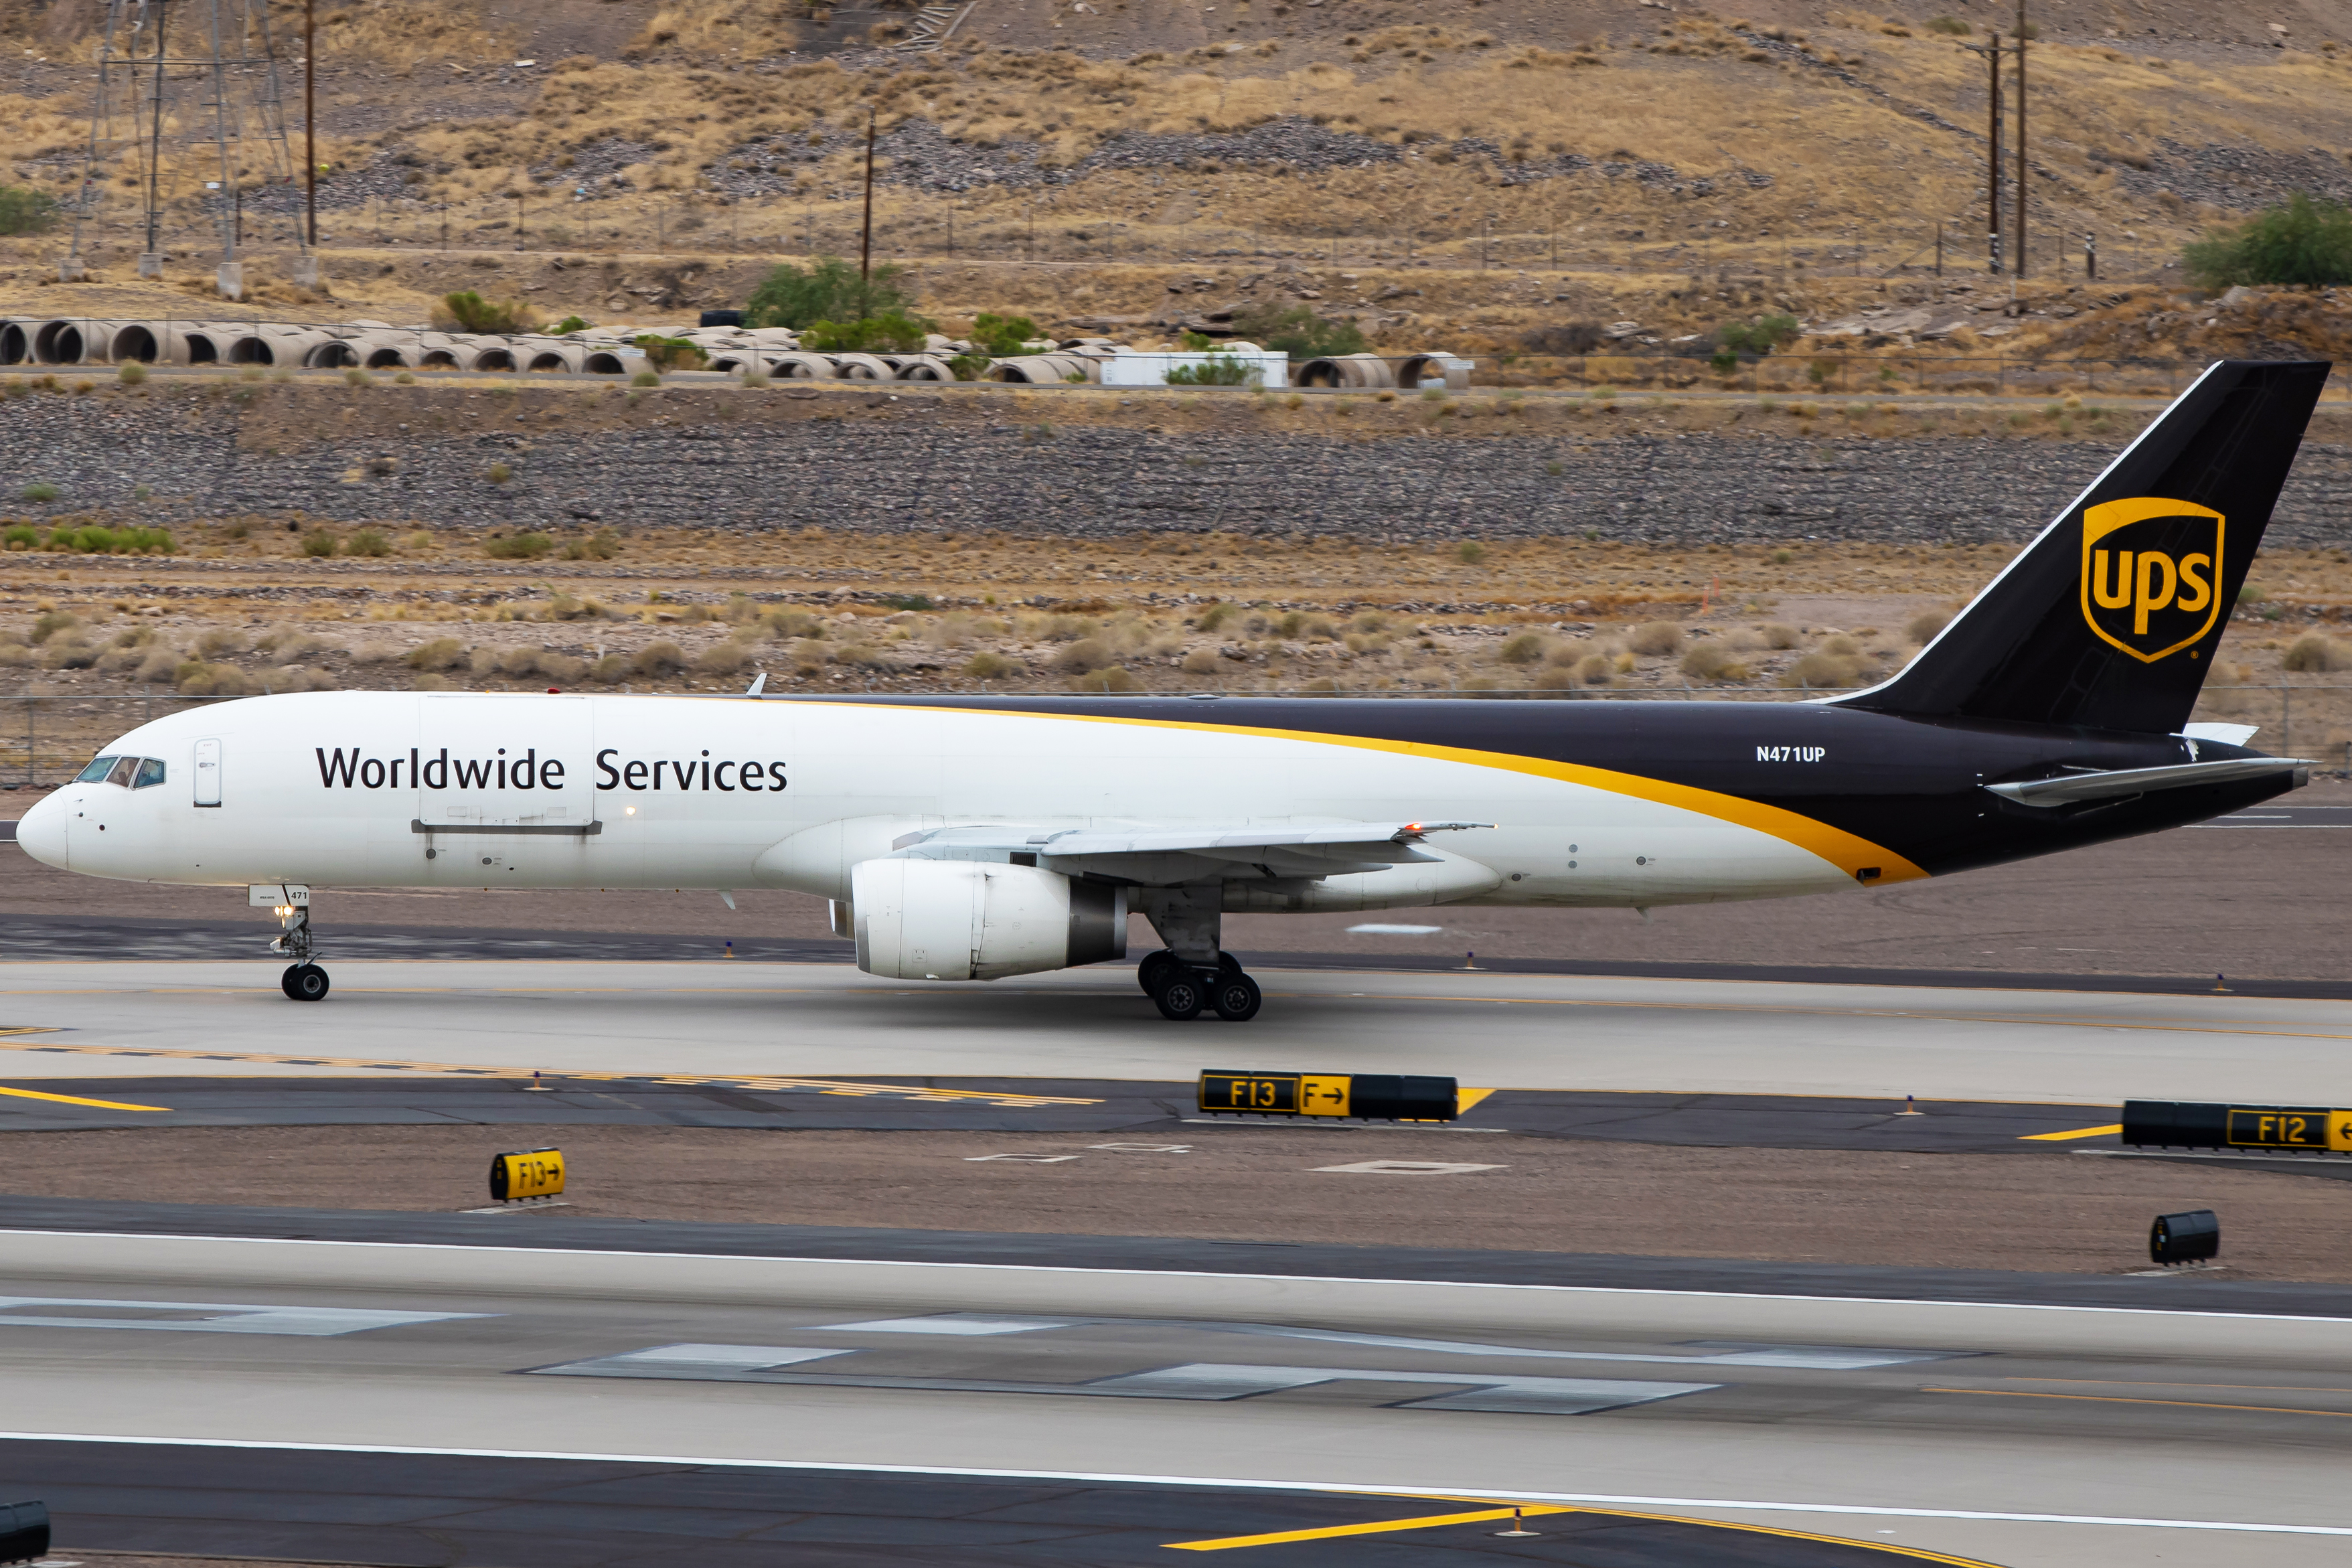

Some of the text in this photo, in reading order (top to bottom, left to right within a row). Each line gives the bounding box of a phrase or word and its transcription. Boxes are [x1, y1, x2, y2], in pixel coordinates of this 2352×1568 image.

[2094, 549, 2211, 635] ups
[1756, 746, 1826, 763] N471UP
[315, 747, 787, 792] Worldwide Services
[291, 891, 307, 900] 471
[1230, 1081, 1320, 1108] F13 F
[2258, 1115, 2307, 1143] F12
[518, 1161, 547, 1190] F13
